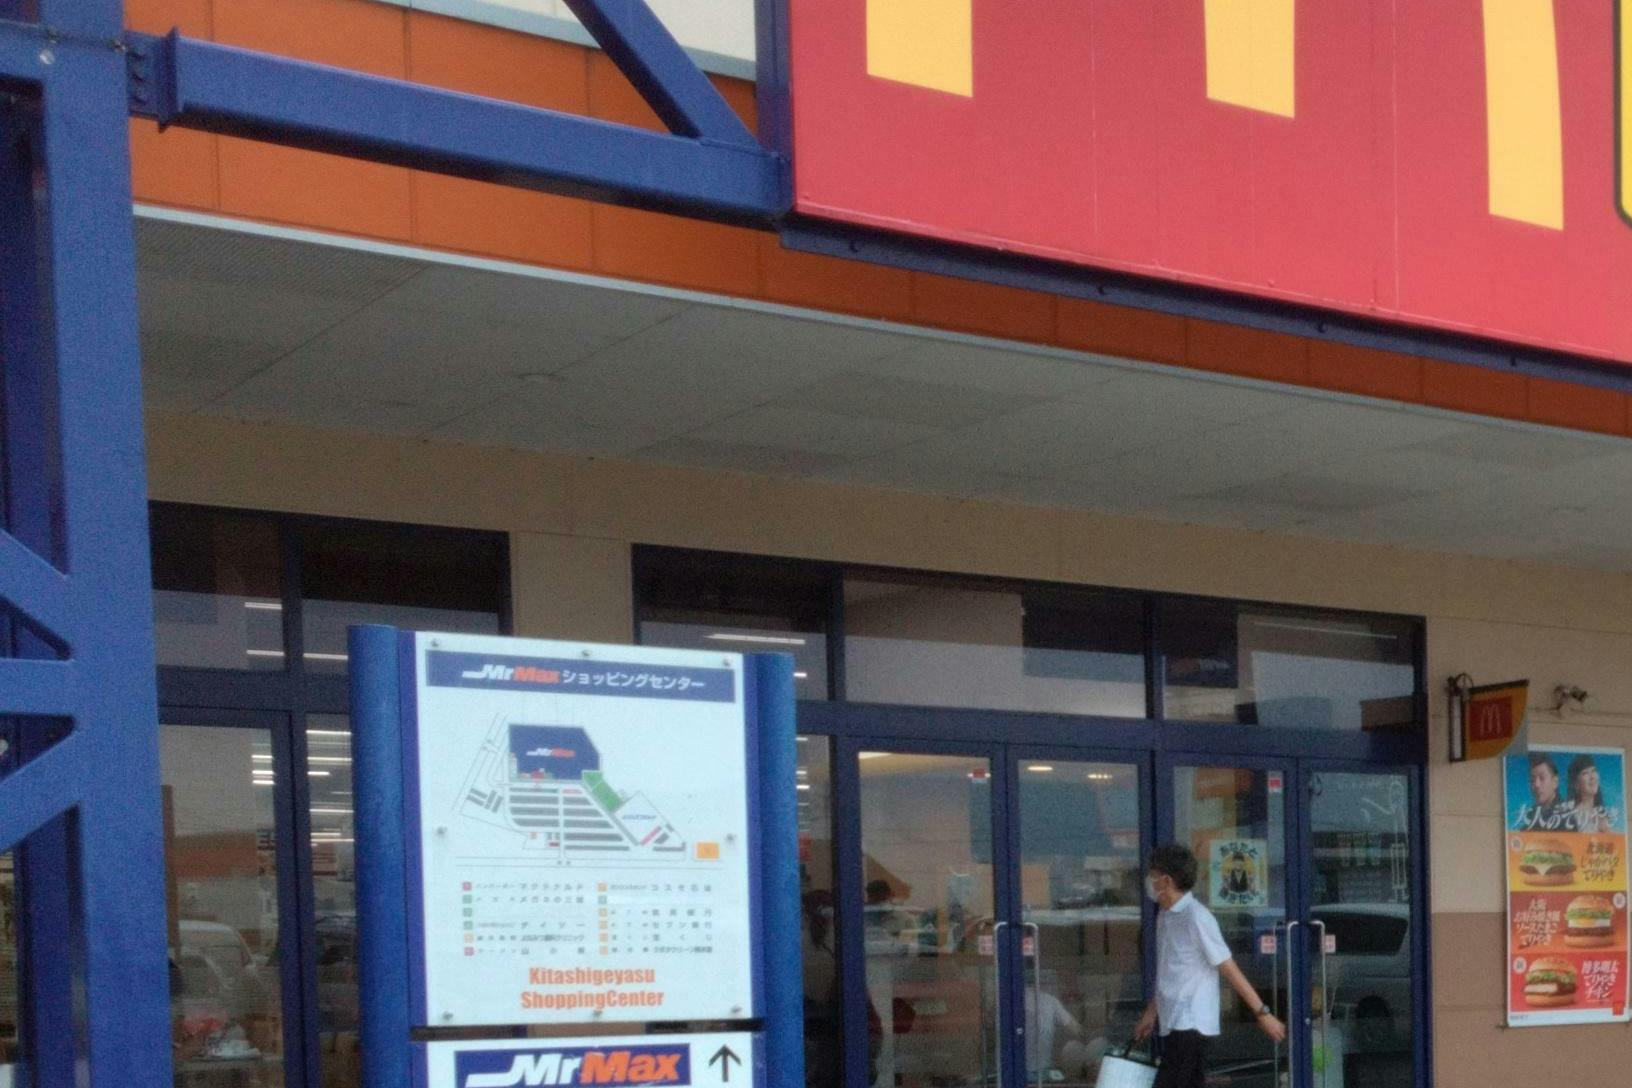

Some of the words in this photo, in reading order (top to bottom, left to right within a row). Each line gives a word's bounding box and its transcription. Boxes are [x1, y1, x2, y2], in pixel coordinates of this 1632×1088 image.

[462, 664, 560, 684] MrMax
[562, 669, 706, 691] ショッピングセンター
[529, 967, 656, 986] Kitashigeyasu
[465, 1051, 682, 1088] MrMax
